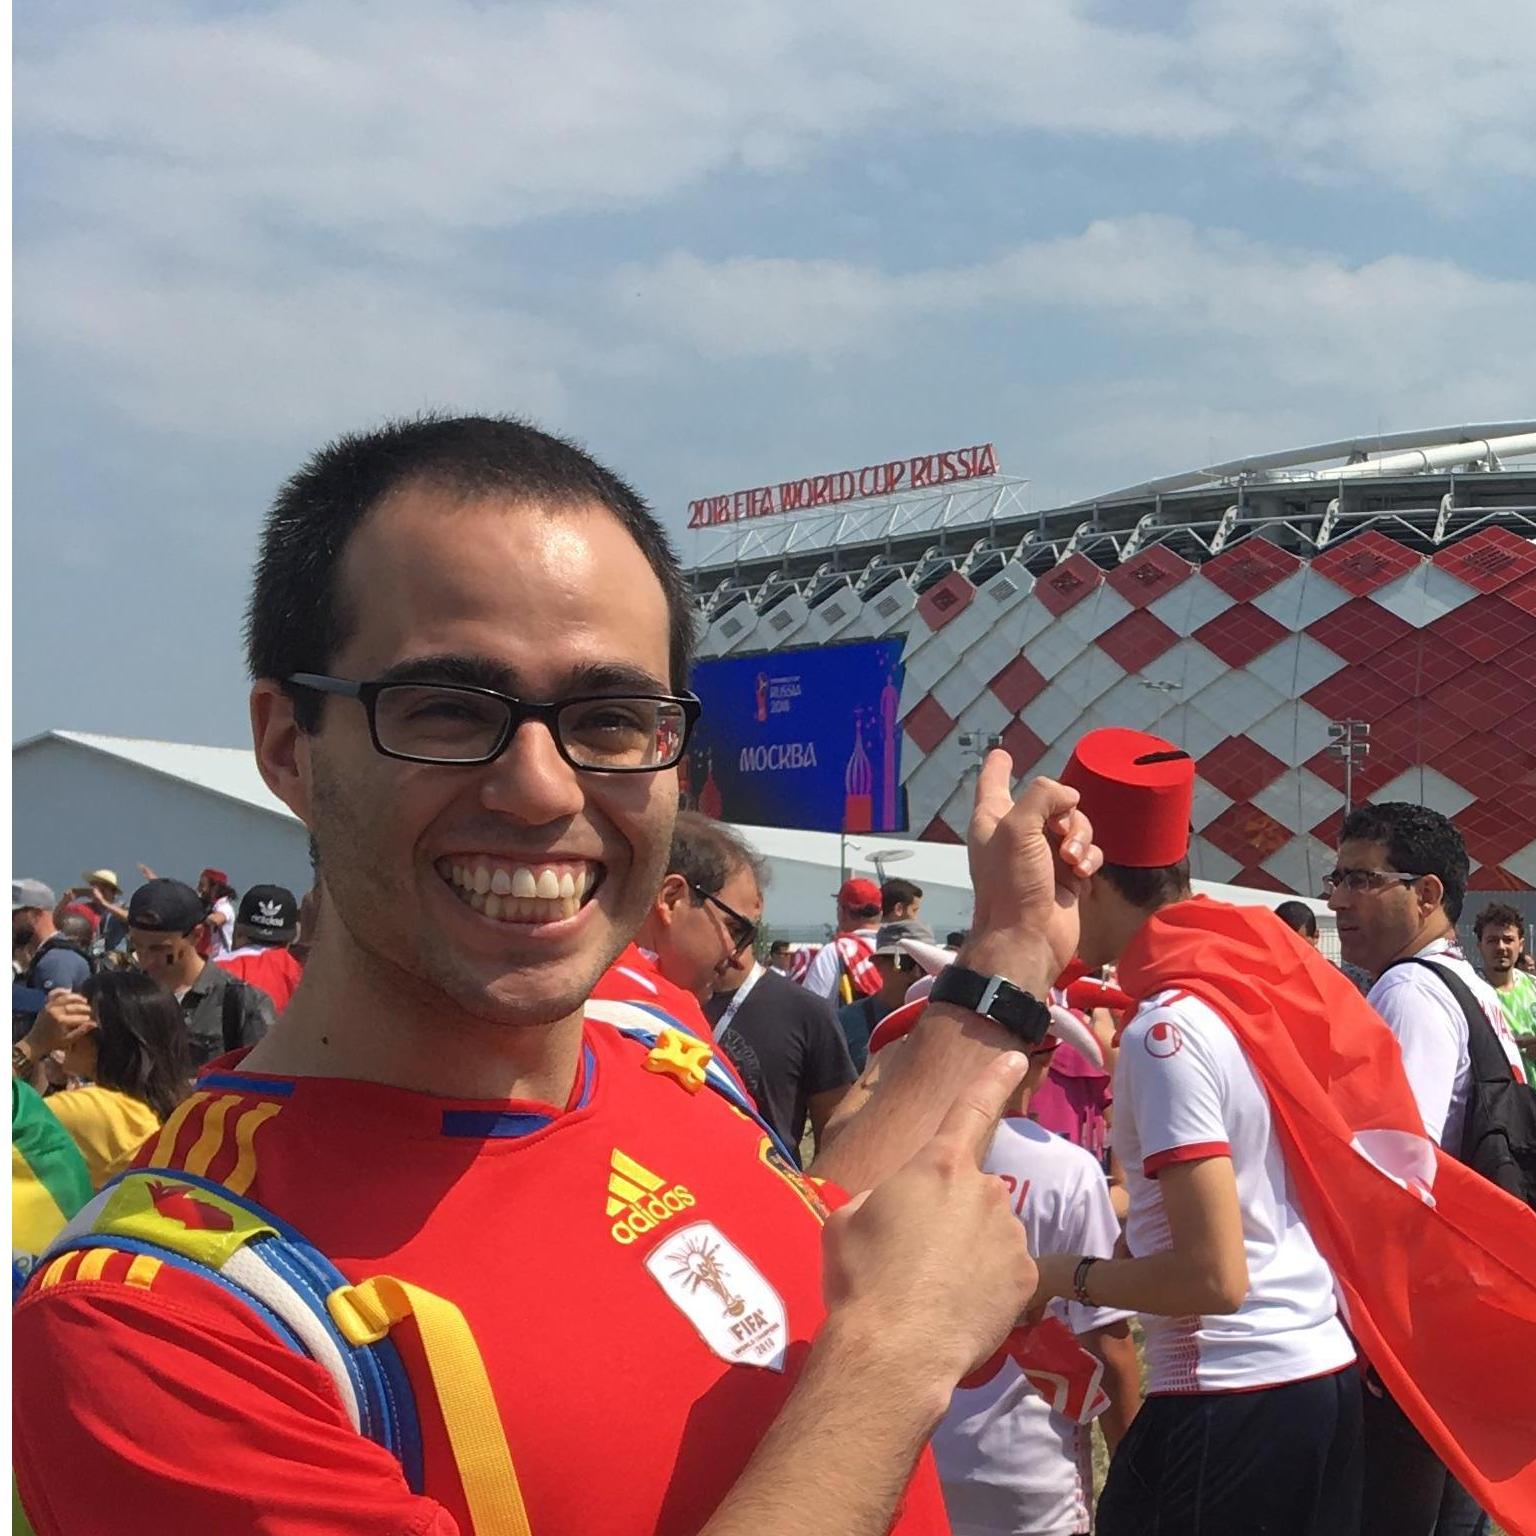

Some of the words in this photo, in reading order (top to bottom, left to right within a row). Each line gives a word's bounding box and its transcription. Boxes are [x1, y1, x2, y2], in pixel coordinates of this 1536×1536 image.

[686, 495, 729, 528] 2018
[734, 486, 774, 518] FIFA
[780, 471, 854, 512] WORLD
[859, 461, 905, 496] CUP
[911, 443, 996, 488] RUSSIA
[740, 742, 817, 771] МОСКВА
[611, 1185, 695, 1244] adidas
[730, 1311, 768, 1341] FIFA
